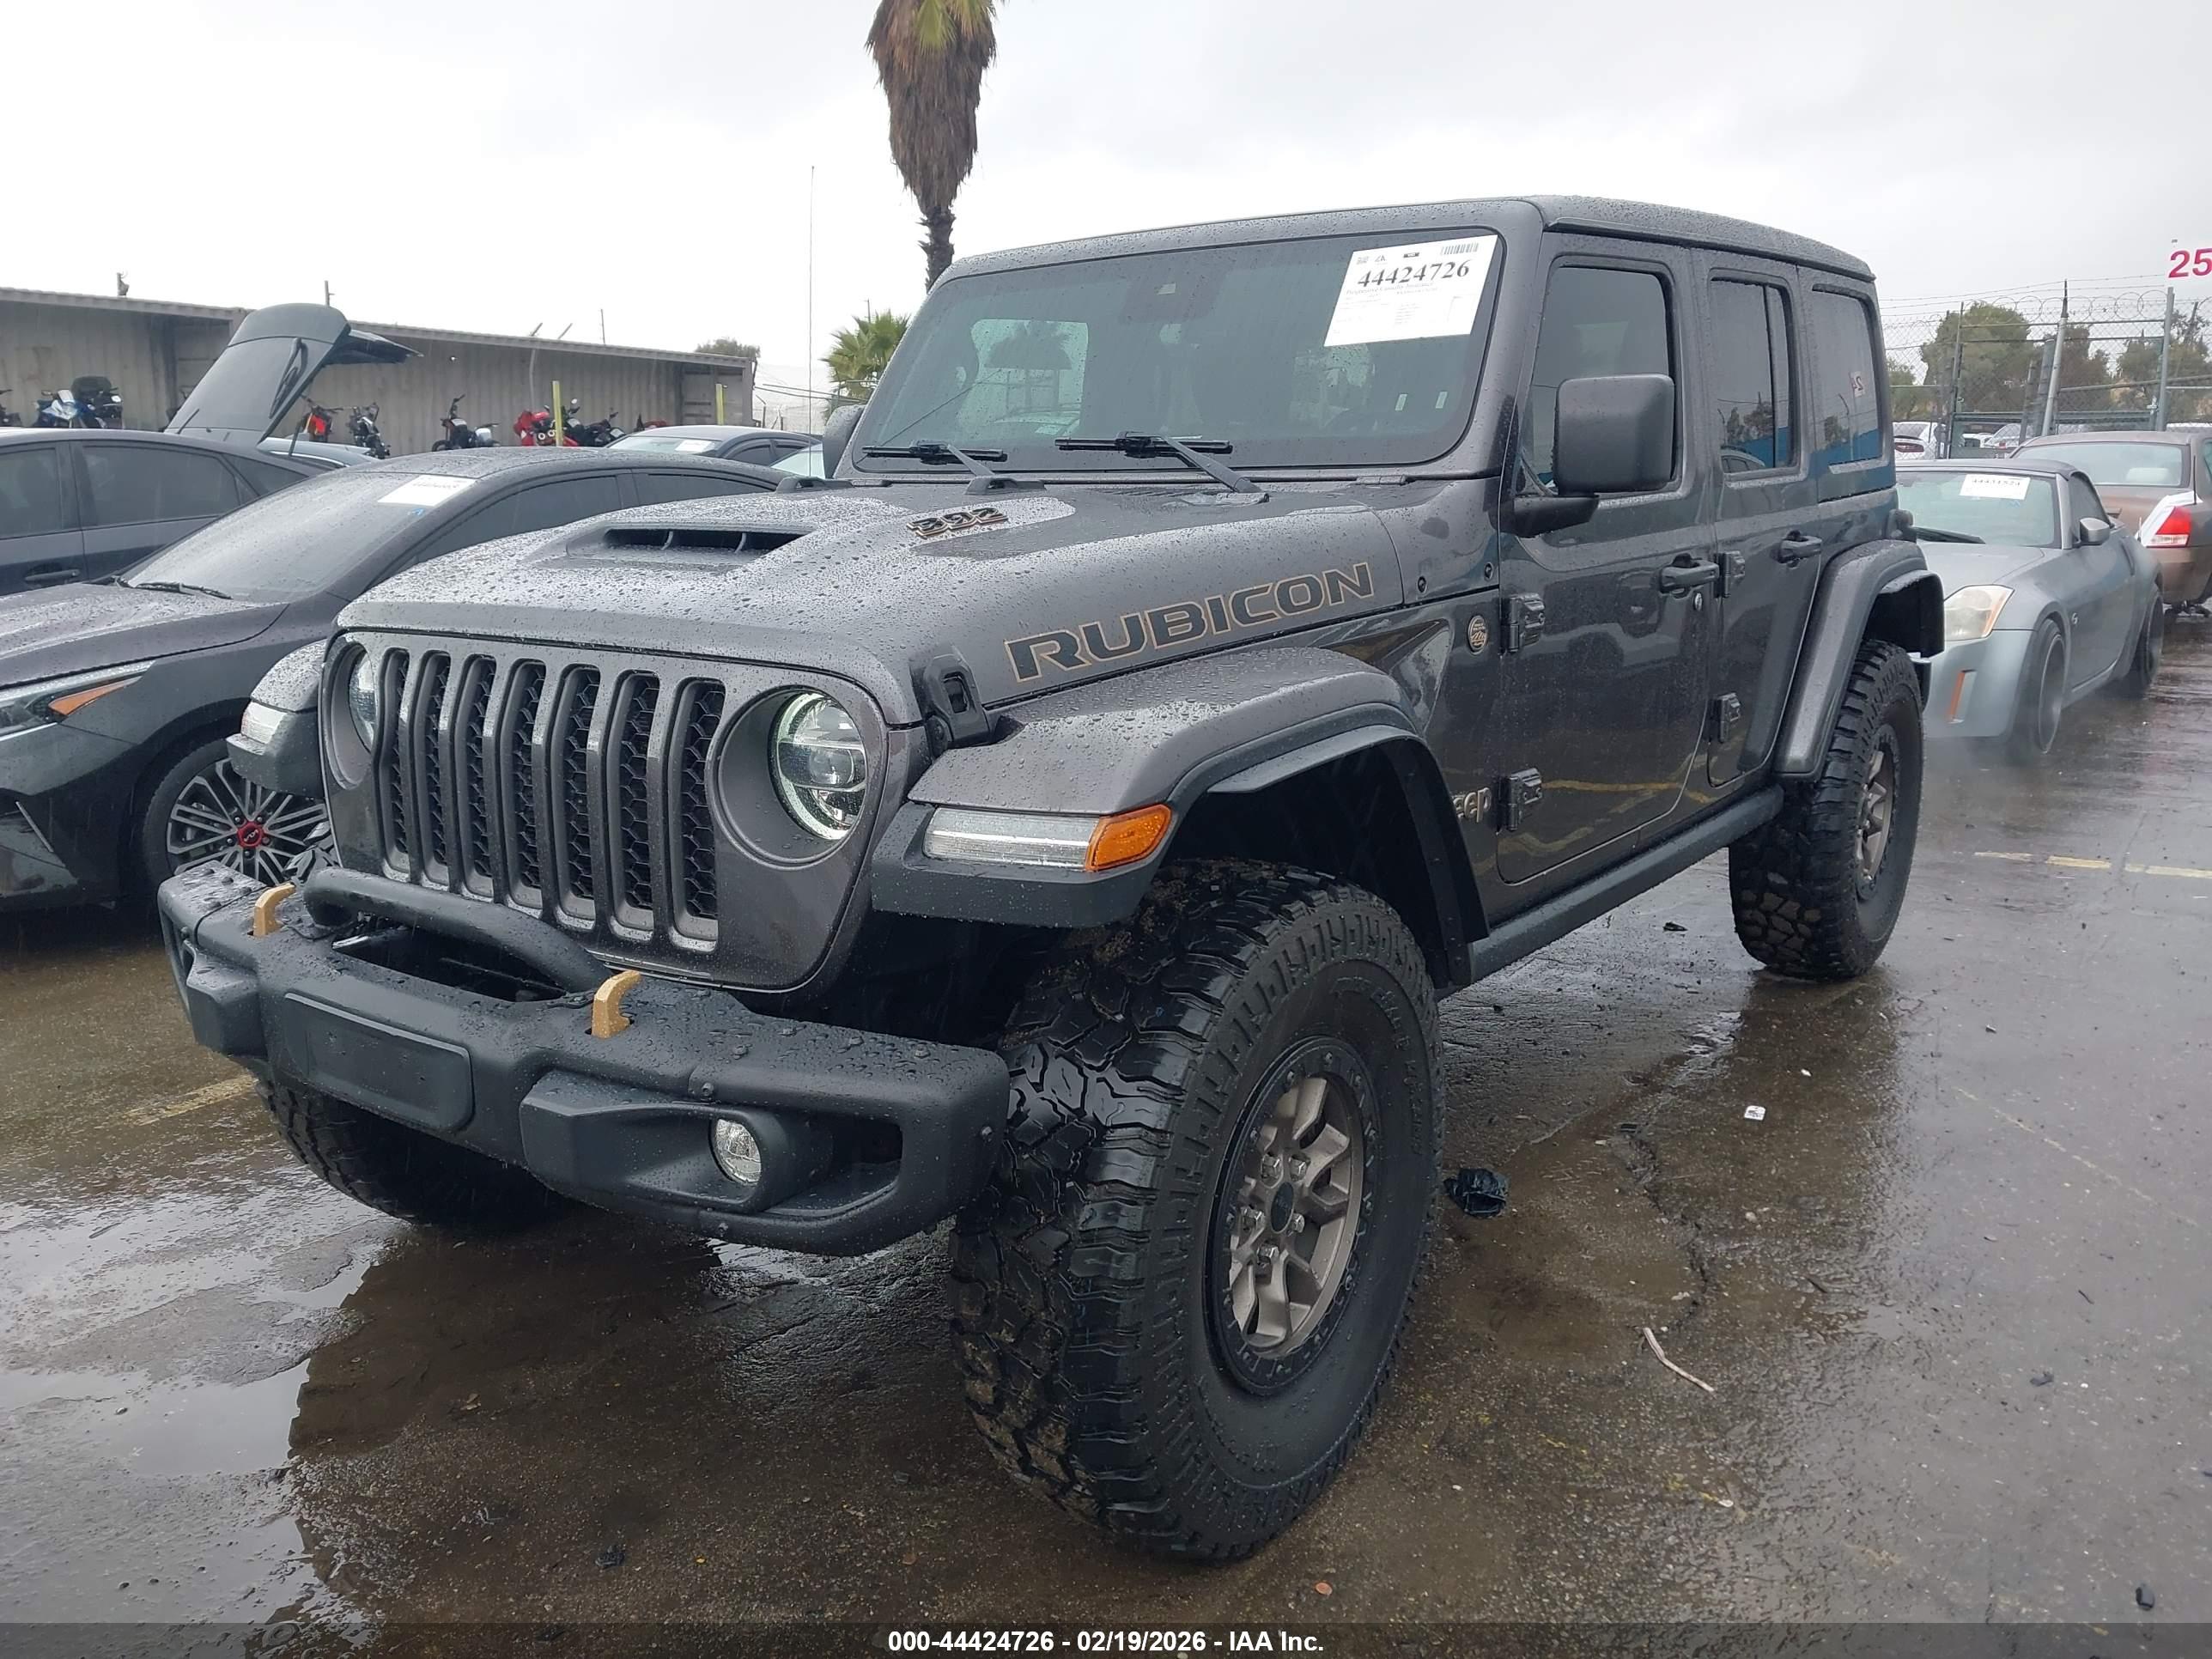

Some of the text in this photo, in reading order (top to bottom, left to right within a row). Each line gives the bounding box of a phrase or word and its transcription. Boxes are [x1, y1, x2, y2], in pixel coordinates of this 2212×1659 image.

[1357, 259, 1472, 288] 44424726
[2168, 248, 2212, 277] 25
[906, 507, 1009, 539] 392
[1006, 562, 1374, 682] RUBICON
[1452, 787, 1492, 823] eep
